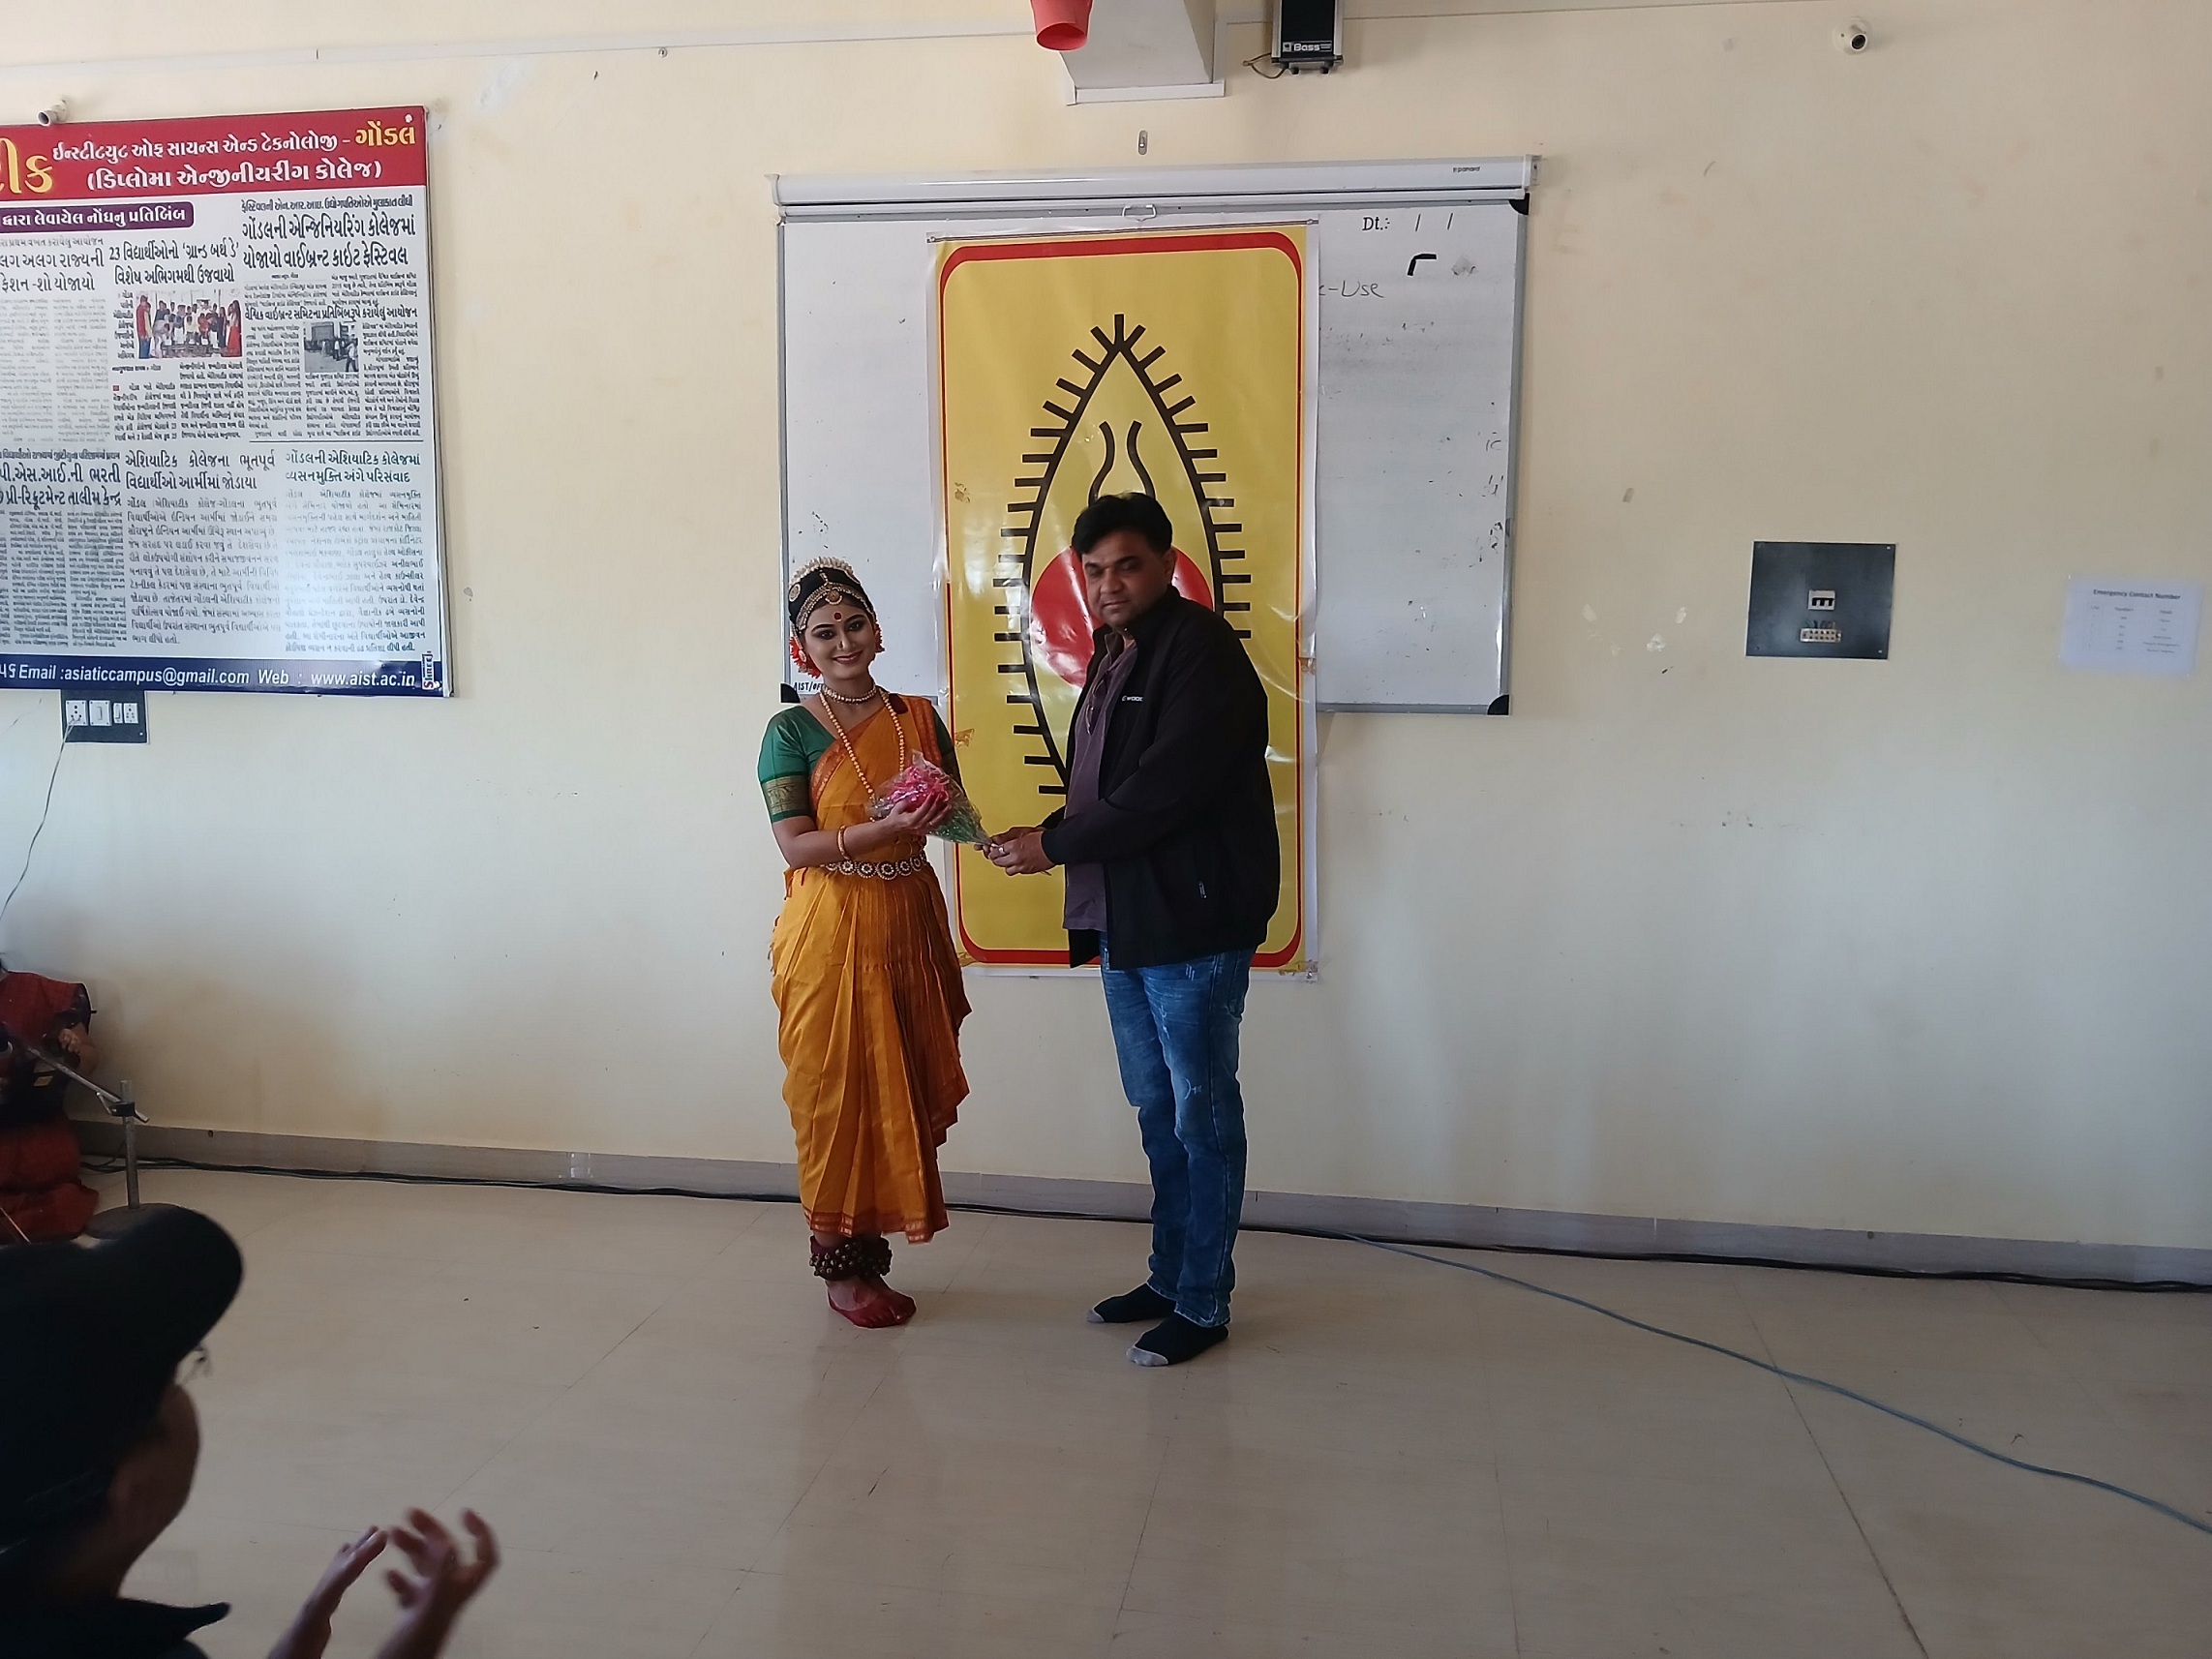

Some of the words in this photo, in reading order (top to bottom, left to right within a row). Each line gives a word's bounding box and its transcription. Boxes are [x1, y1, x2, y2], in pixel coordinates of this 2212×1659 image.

[132, 138, 164, 158] ઓફ
[167, 139, 219, 157] સાયન્સ
[223, 134, 258, 154] એન્ડ
[260, 130, 338, 152] ટેકનોલોજી
[87, 166, 171, 191] (ડિપ્લોમા
[316, 156, 382, 180] કોલેજ)
[35, 209, 84, 226] લેવાયેલ
[129, 205, 186, 223] પ્રતિબિંબ
[242, 215, 288, 240] ગોંડલની
[288, 211, 366, 238] એન્જિનિયરિંગ
[368, 211, 416, 236] કોલેજમાં
[22, 254, 57, 268] અલગ
[59, 248, 105, 267] રાજ્યની
[109, 247, 121, 261] 23
[124, 240, 180, 261] વિદ્યાર્થીઓનો
[209, 237, 228, 258] બર્થ
[242, 244, 283, 269] યોજાયો
[362, 240, 409, 268] ફેસ્ટિવલ
[54, 272, 95, 290] યોજાયો
[114, 264, 142, 285] વિશેષ
[144, 263, 196, 285] અભિગમથી
[197, 262, 235, 283] ઉજવાયો
[387, 304, 418, 318] આયોજન
[126, 449, 178, 468] એશિયાટિક
[190, 449, 230, 468] કોલેજના
[240, 448, 275, 471] ભૂતપૂર્વ
[286, 449, 326, 465] ગોંડલની
[327, 449, 379, 466] એશિયાટિક
[381, 451, 421, 466] કોલેજમાં
[89, 463, 121, 483] ભરતી
[126, 470, 178, 490] વિદ્યાર્થીઓ
[179, 470, 221, 490] આર્મીમાં
[223, 470, 258, 490] જોડાયા
[286, 467, 343, 486] વ્યસનમુક્તિ
[345, 468, 365, 482] અંગે
[366, 468, 411, 483] પરિસંવાદ
[68, 485, 101, 505] તાલીમ
[101, 485, 122, 506] કેન્દ્ર
[2093, 588, 2128, 597] Emergency
[19, 664, 56, 679] Email
[258, 670, 288, 684] Web
[312, 670, 415, 687] www.aist.ac.in
